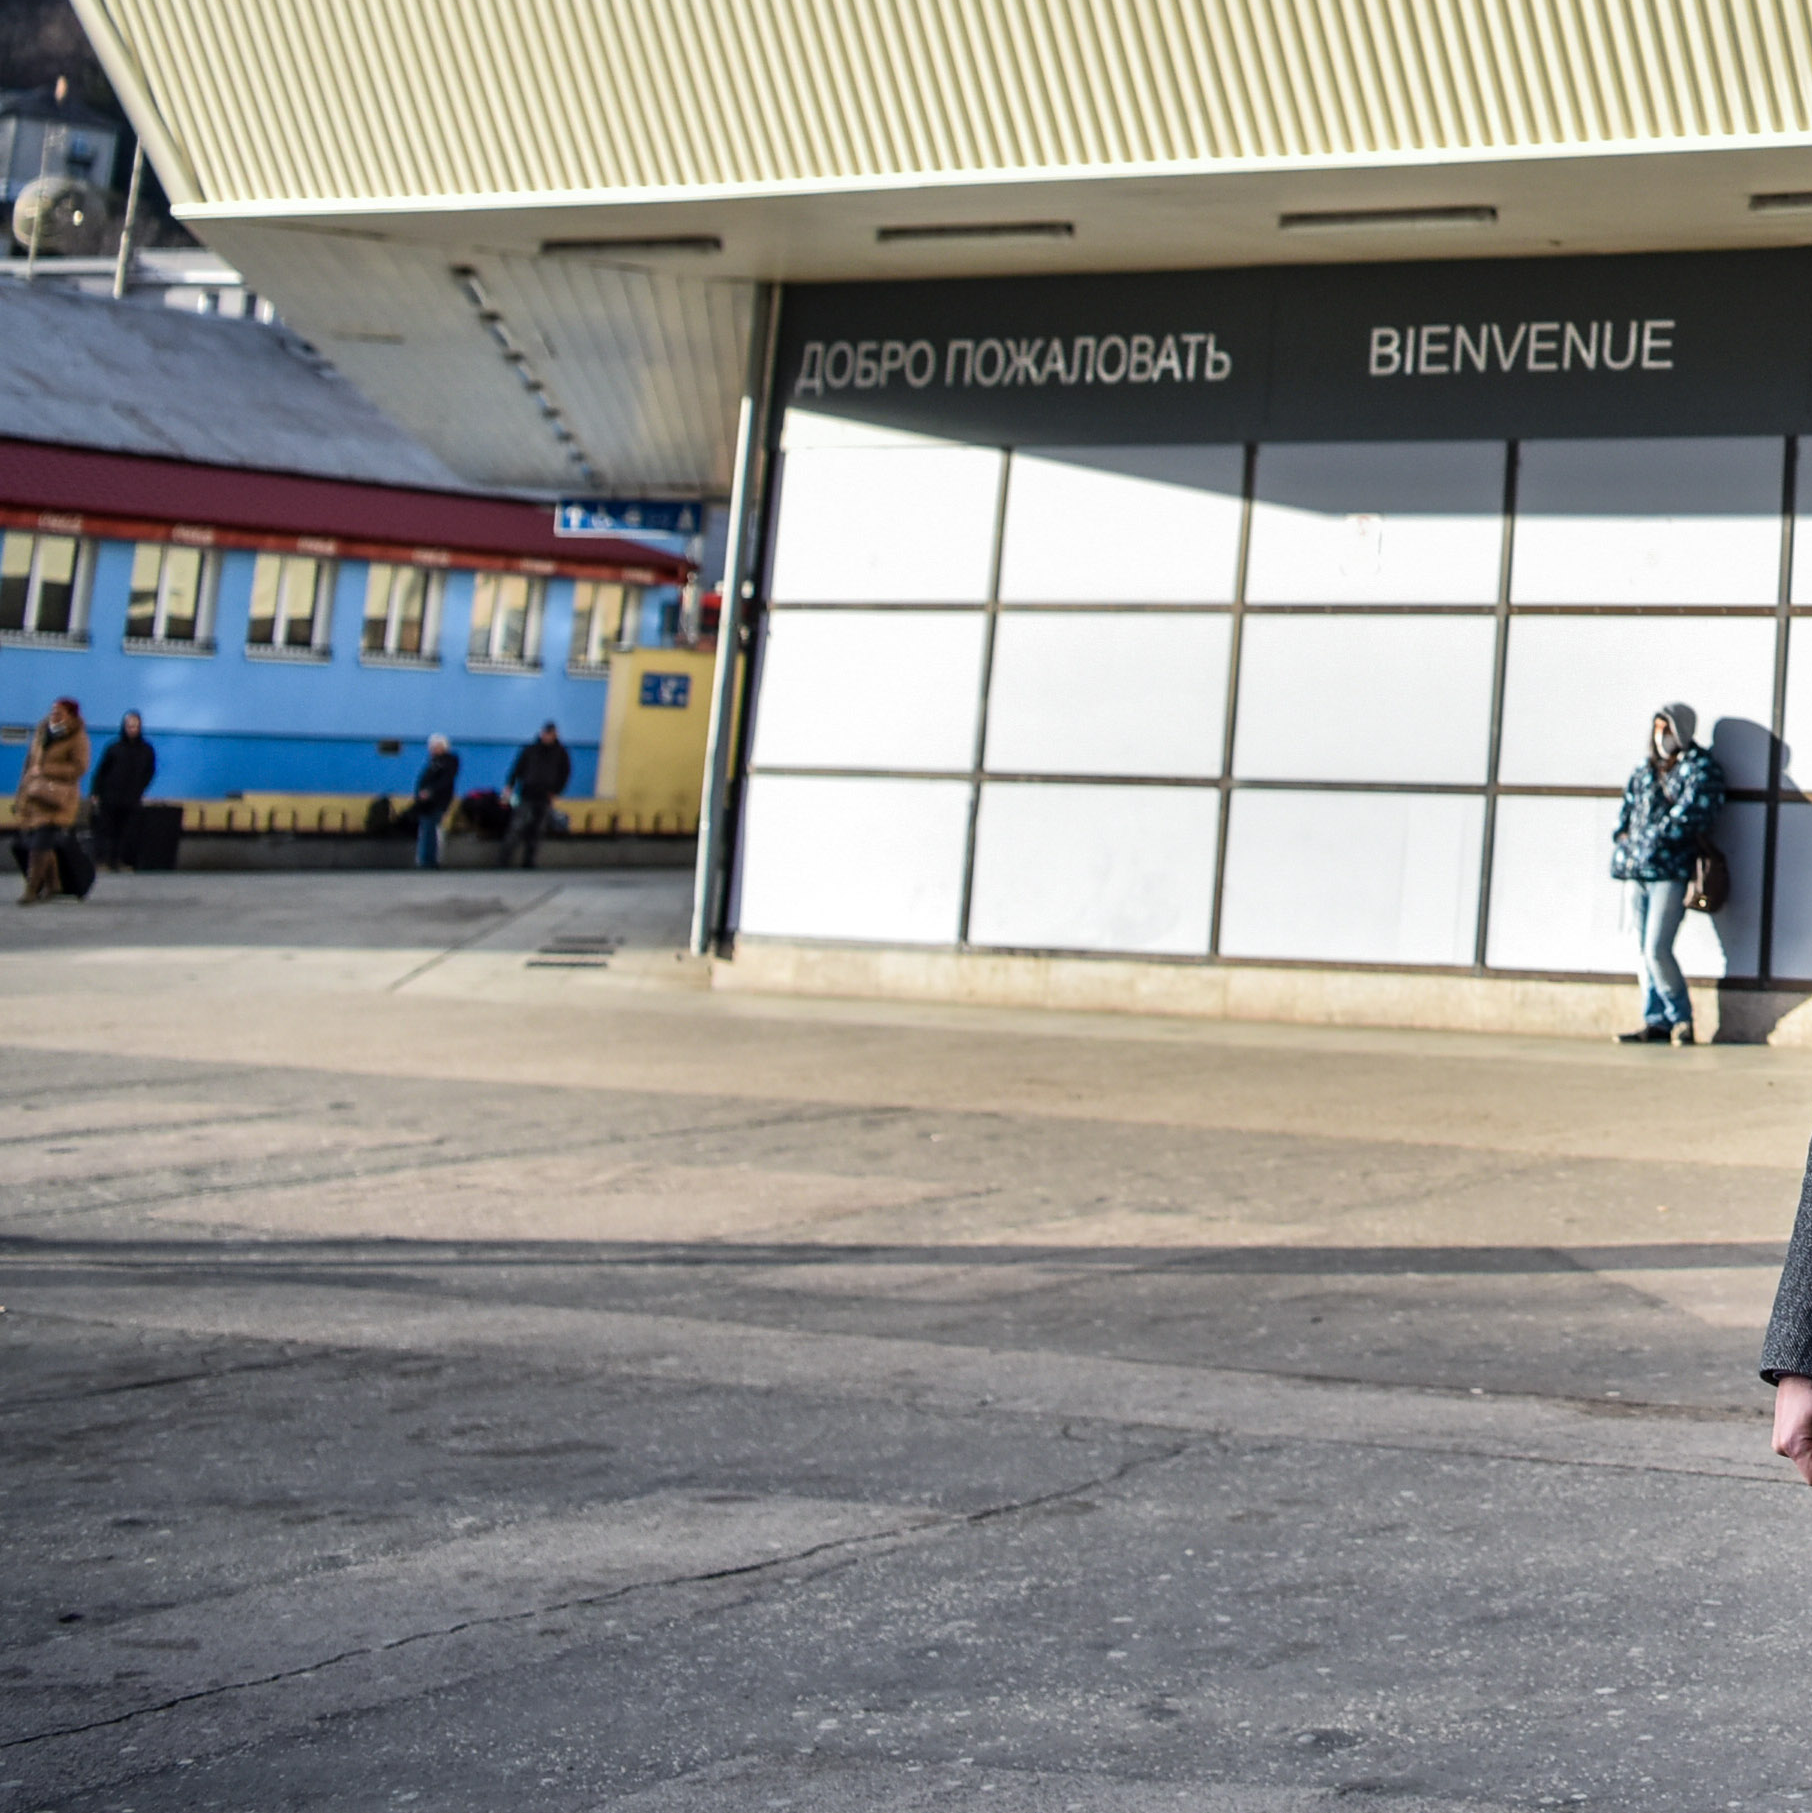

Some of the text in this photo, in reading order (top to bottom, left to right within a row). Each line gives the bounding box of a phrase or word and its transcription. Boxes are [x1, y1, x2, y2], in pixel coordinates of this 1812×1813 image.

[795, 333, 1232, 397] ДОБРО ПОЖАЛОВАТЬ
[1369, 320, 1675, 375] BIENVENUE
